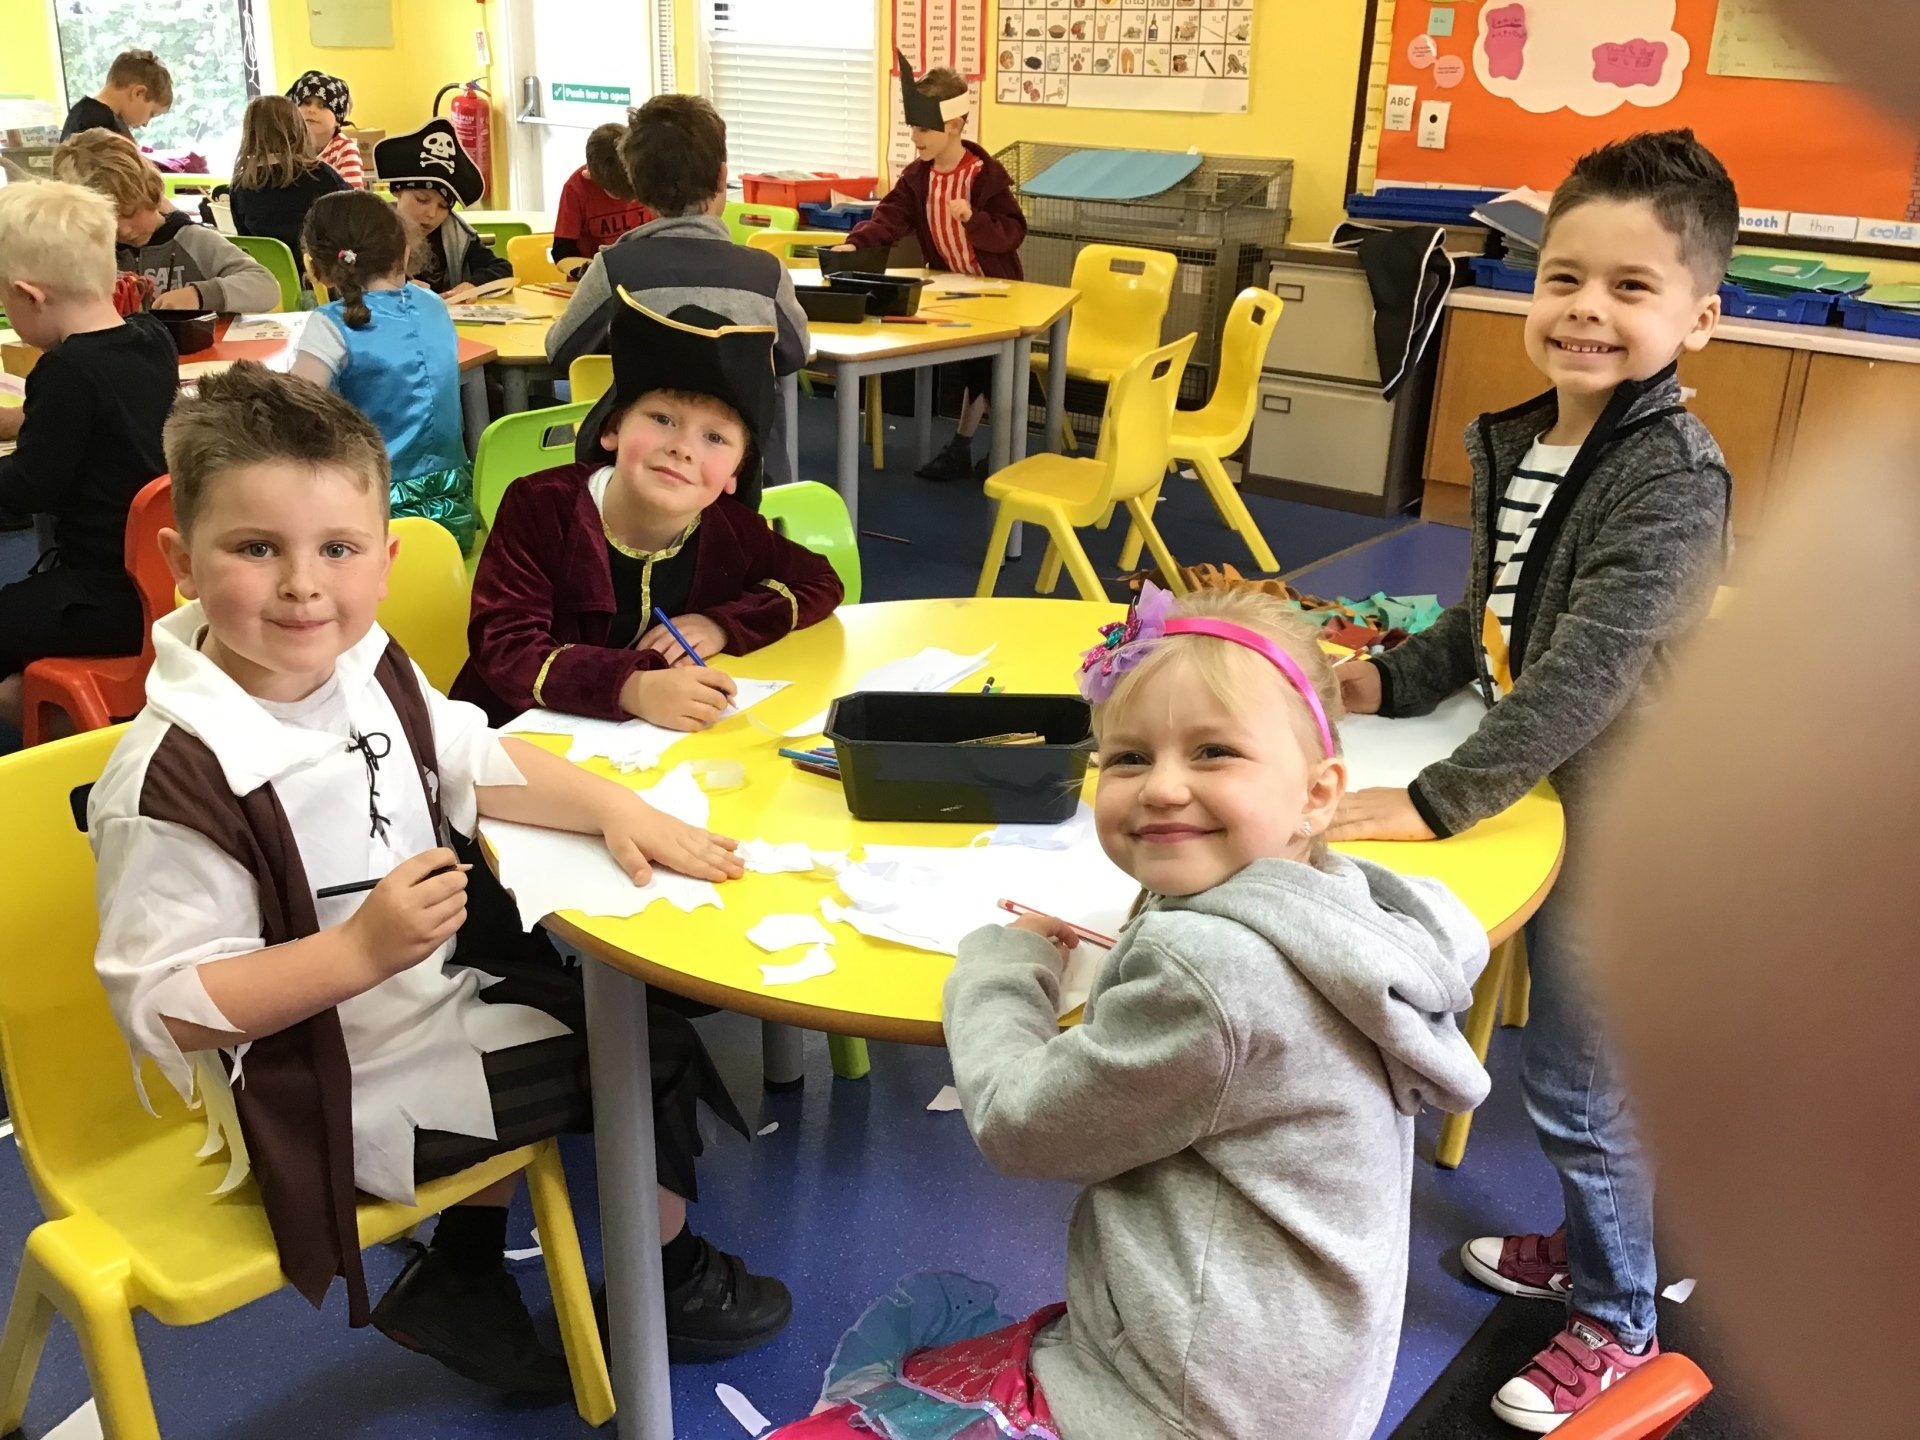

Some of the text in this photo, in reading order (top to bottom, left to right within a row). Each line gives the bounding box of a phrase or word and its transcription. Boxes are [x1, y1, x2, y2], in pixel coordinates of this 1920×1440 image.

[565, 87, 630, 104] Push bar to open
[1390, 96, 1411, 107] ABC
[600, 214, 631, 235] ALL
[1739, 214, 1779, 229] ooth
[1810, 218, 1835, 234] thin
[1869, 225, 1913, 240] cold
